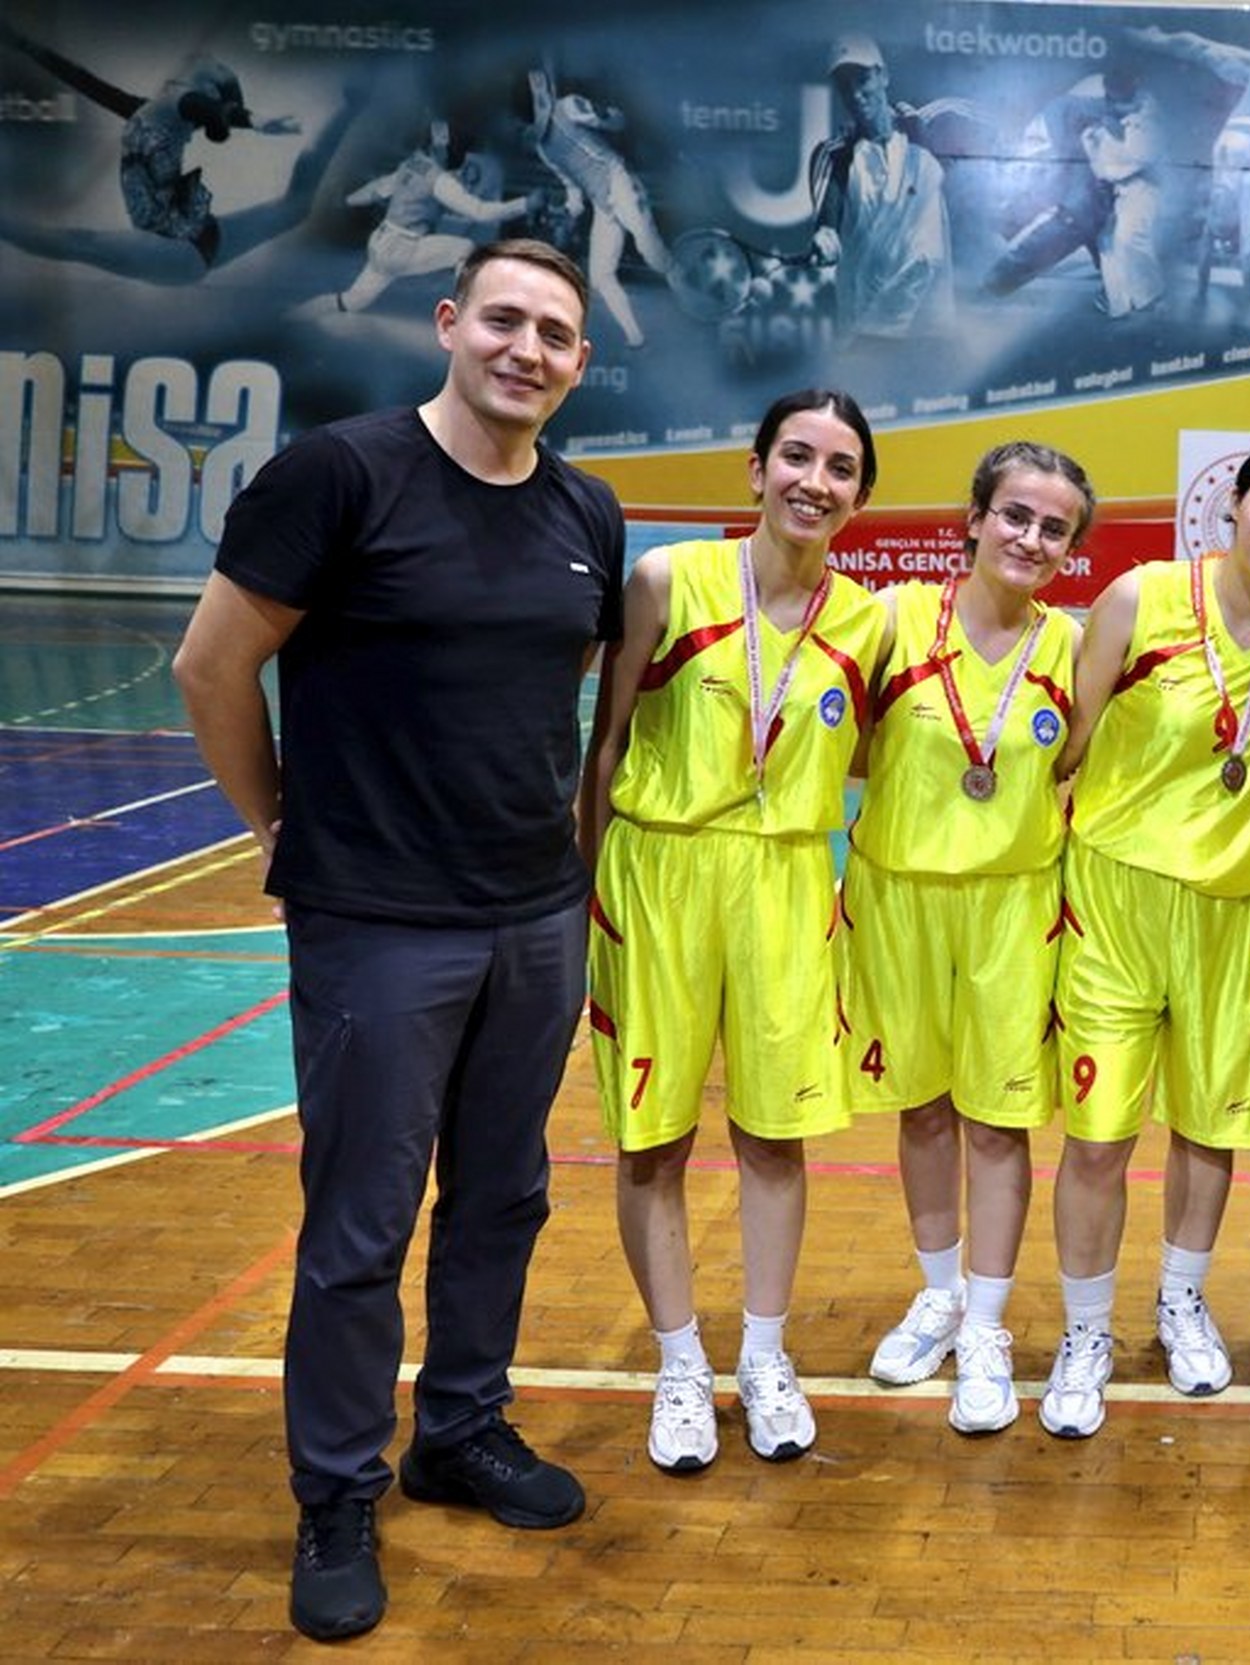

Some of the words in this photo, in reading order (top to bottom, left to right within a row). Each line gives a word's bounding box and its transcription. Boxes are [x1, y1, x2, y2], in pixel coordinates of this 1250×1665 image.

[925, 22, 1107, 59] taekwondo
[681, 100, 779, 131] tennis
[922, 539, 936, 549] VE
[826, 549, 894, 572] ANİSA
[898, 553, 971, 577] GENÇL
[859, 1038, 886, 1083] 4
[1072, 1053, 1097, 1104] 9
[630, 1056, 653, 1110] 7
